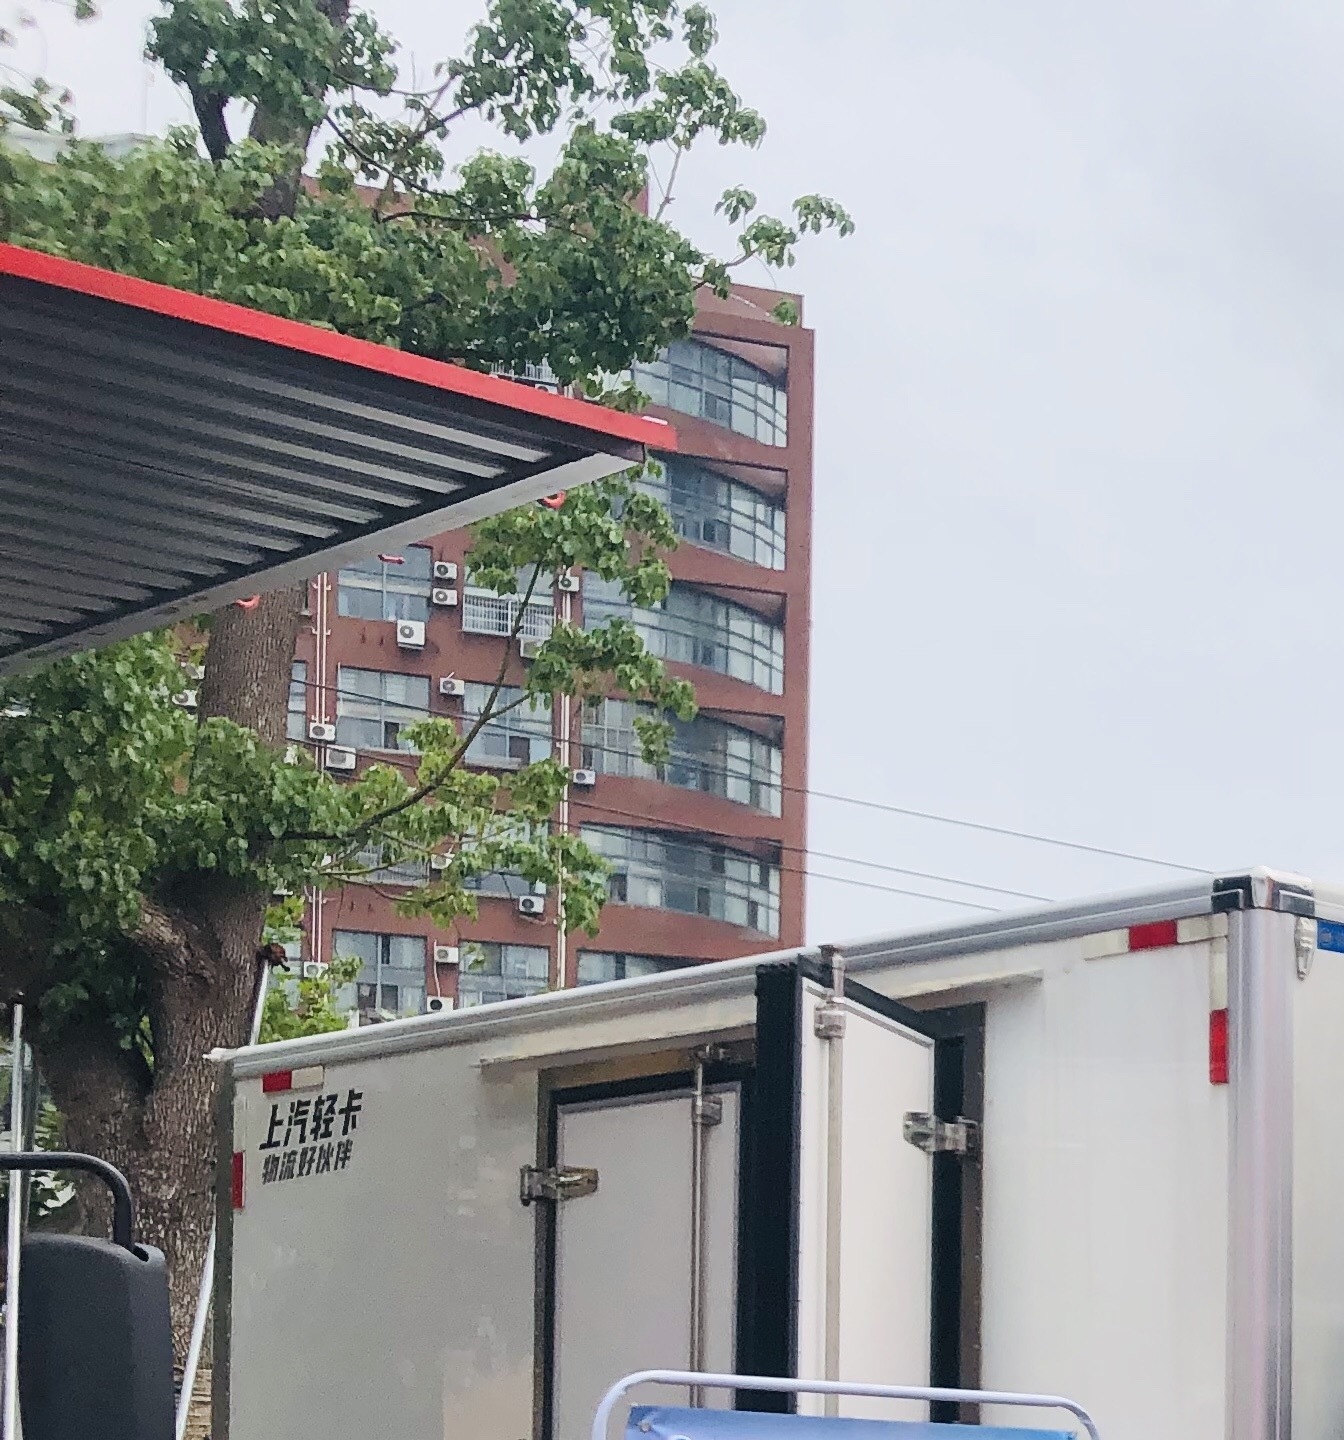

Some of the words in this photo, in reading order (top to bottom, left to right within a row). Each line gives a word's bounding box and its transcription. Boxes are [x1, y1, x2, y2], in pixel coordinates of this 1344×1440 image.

[259, 1088, 363, 1150] 上汽轻卡
[262, 1139, 353, 1185] 物流好伙伴
